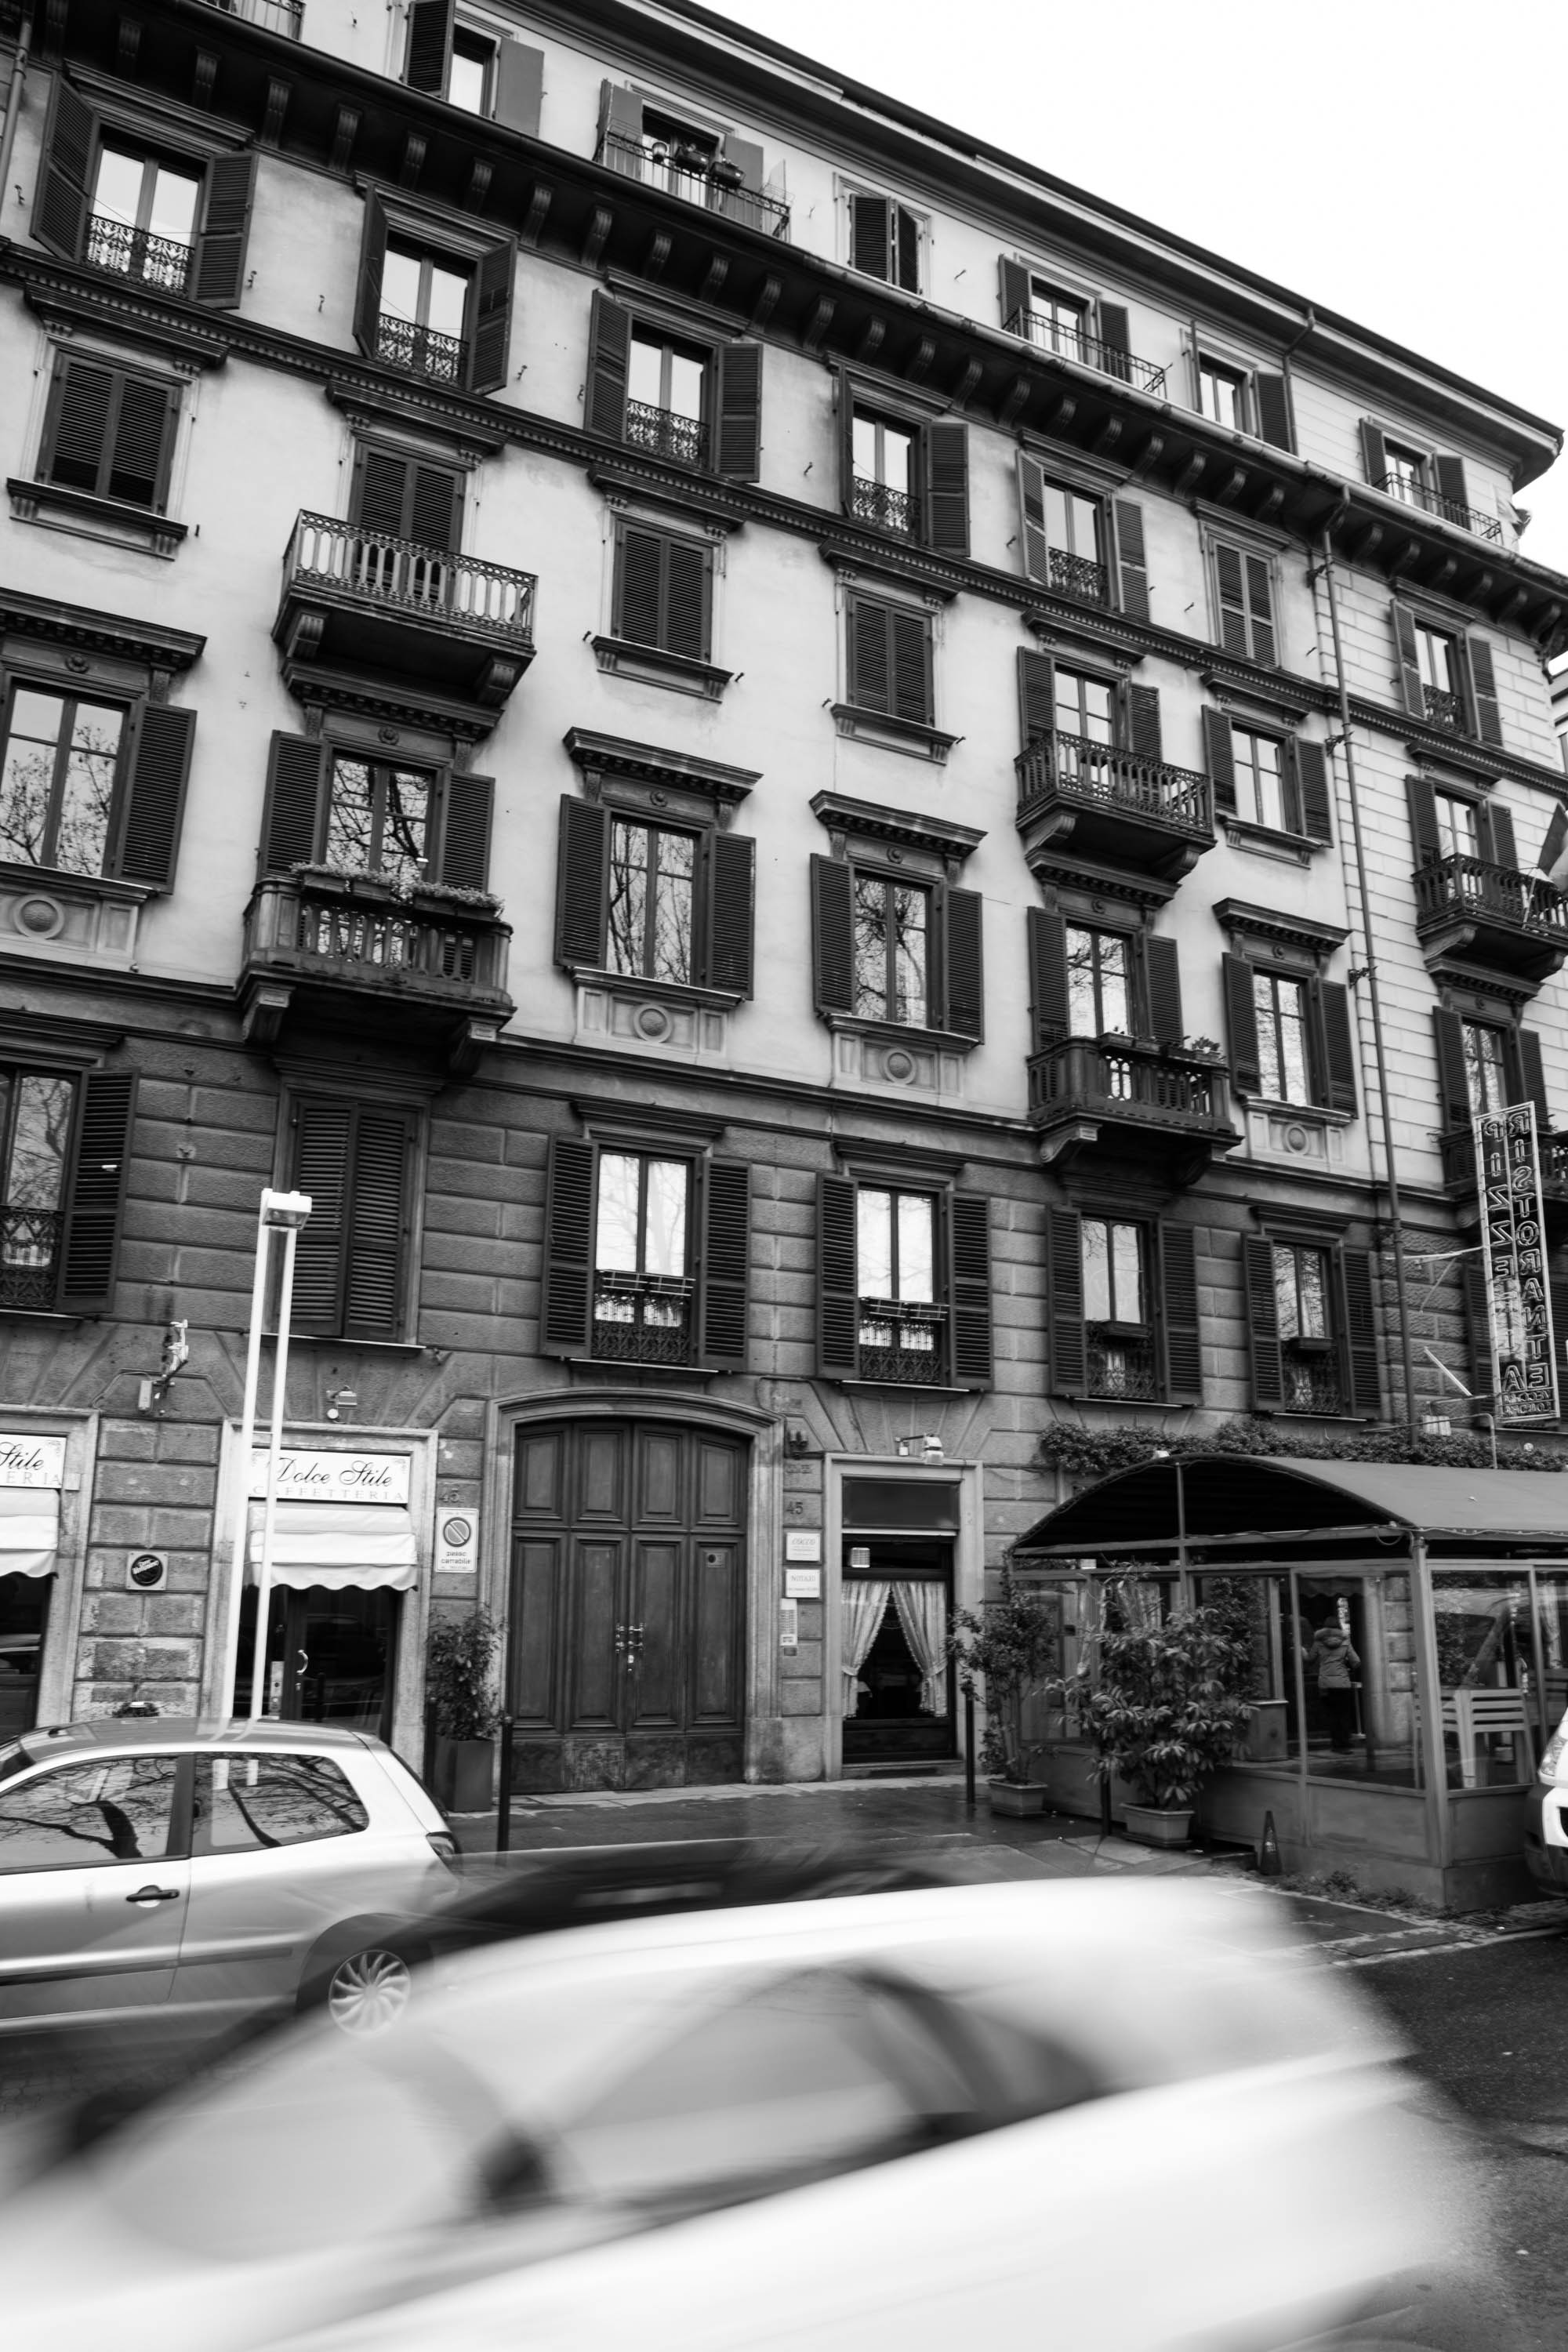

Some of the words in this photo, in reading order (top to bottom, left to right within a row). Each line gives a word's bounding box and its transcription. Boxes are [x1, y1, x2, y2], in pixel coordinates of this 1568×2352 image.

[275, 1456, 330, 1485] Dolce
[338, 1460, 394, 1488] Stile
[252, 1485, 405, 1501] CFFETTERIA
[786, 1501, 804, 1515] 45
